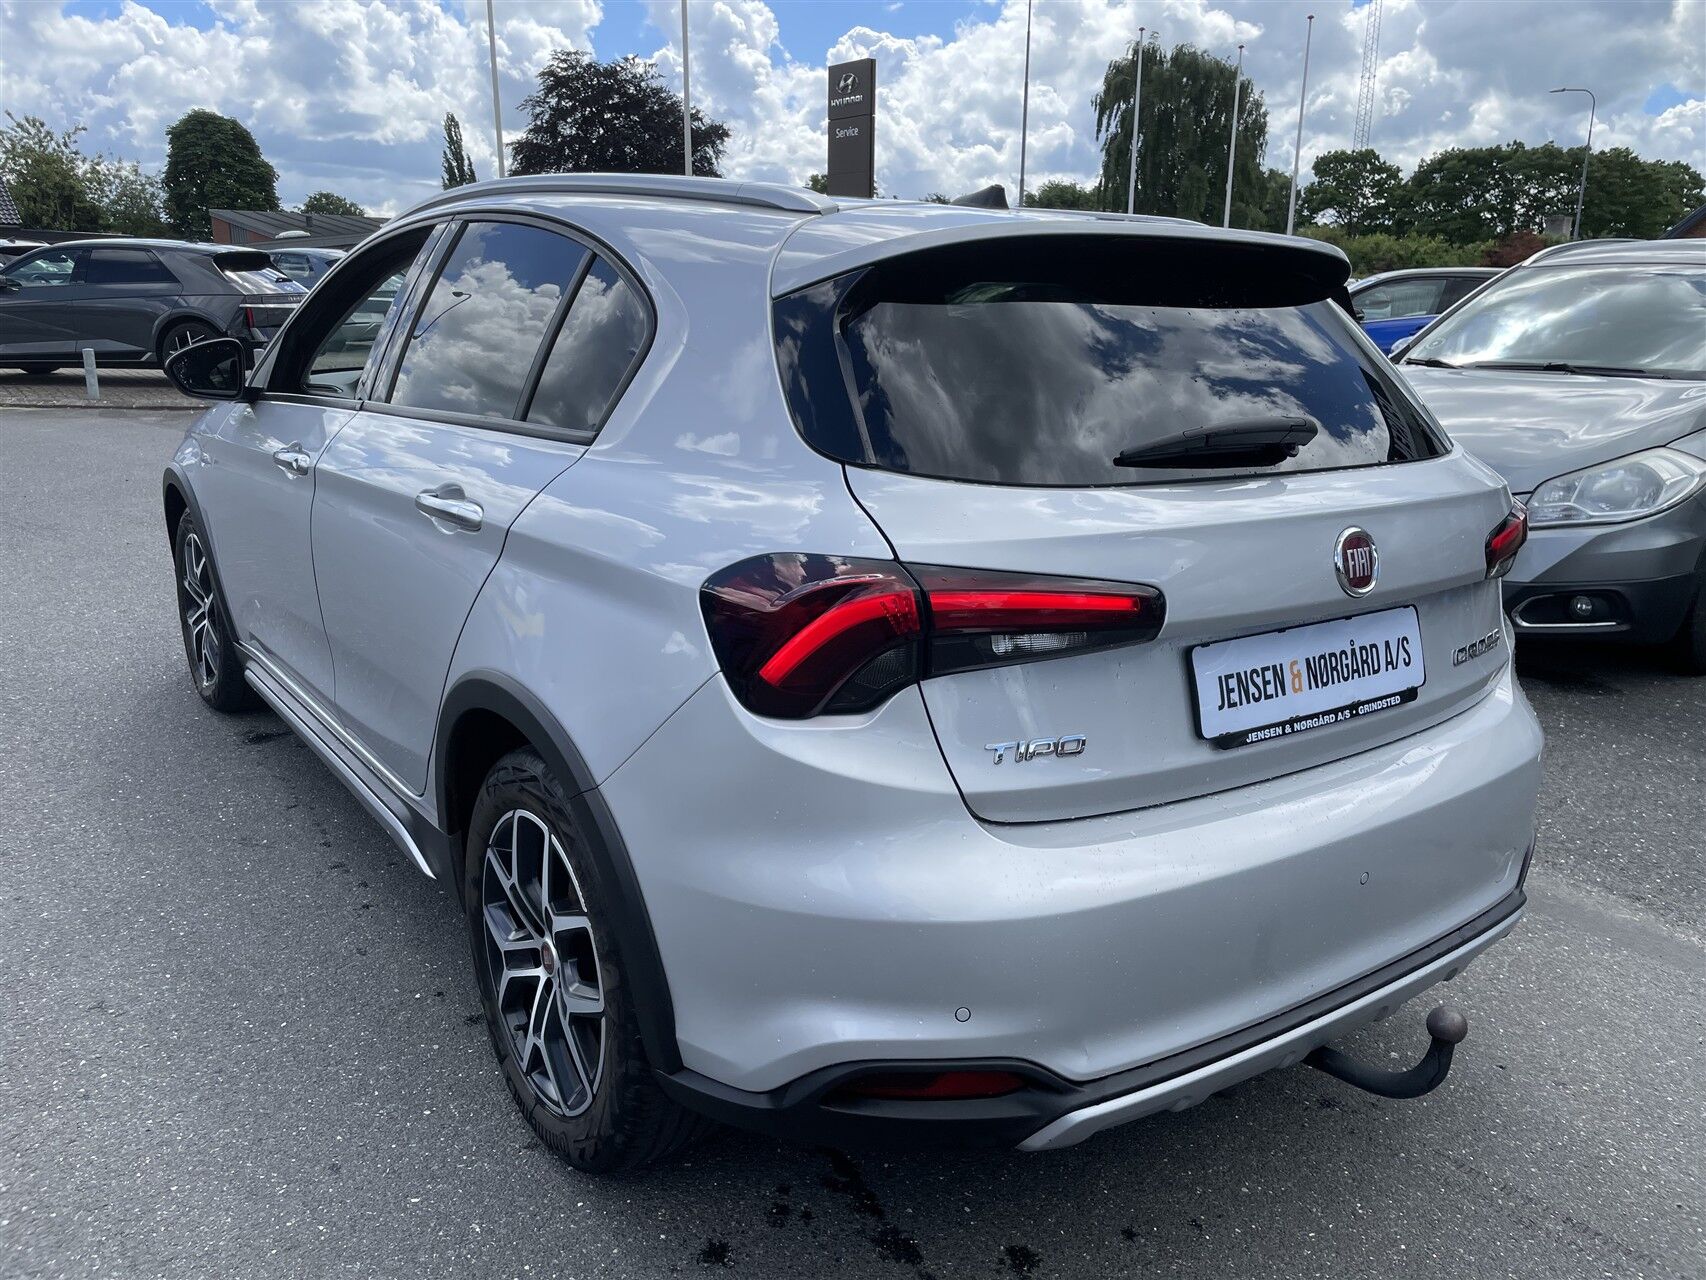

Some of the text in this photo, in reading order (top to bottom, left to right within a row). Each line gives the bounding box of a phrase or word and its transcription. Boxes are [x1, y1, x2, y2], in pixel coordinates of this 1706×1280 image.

[836, 126, 859, 138] Service
[1347, 547, 1370, 578] FIAT
[1218, 636, 1412, 711] JENSEN & NØRGÅRD A/S
[1246, 695, 1401, 743] JENSEN & NØRGÅRD A/S GRINDSTED
[984, 734, 1086, 765] TIPO
